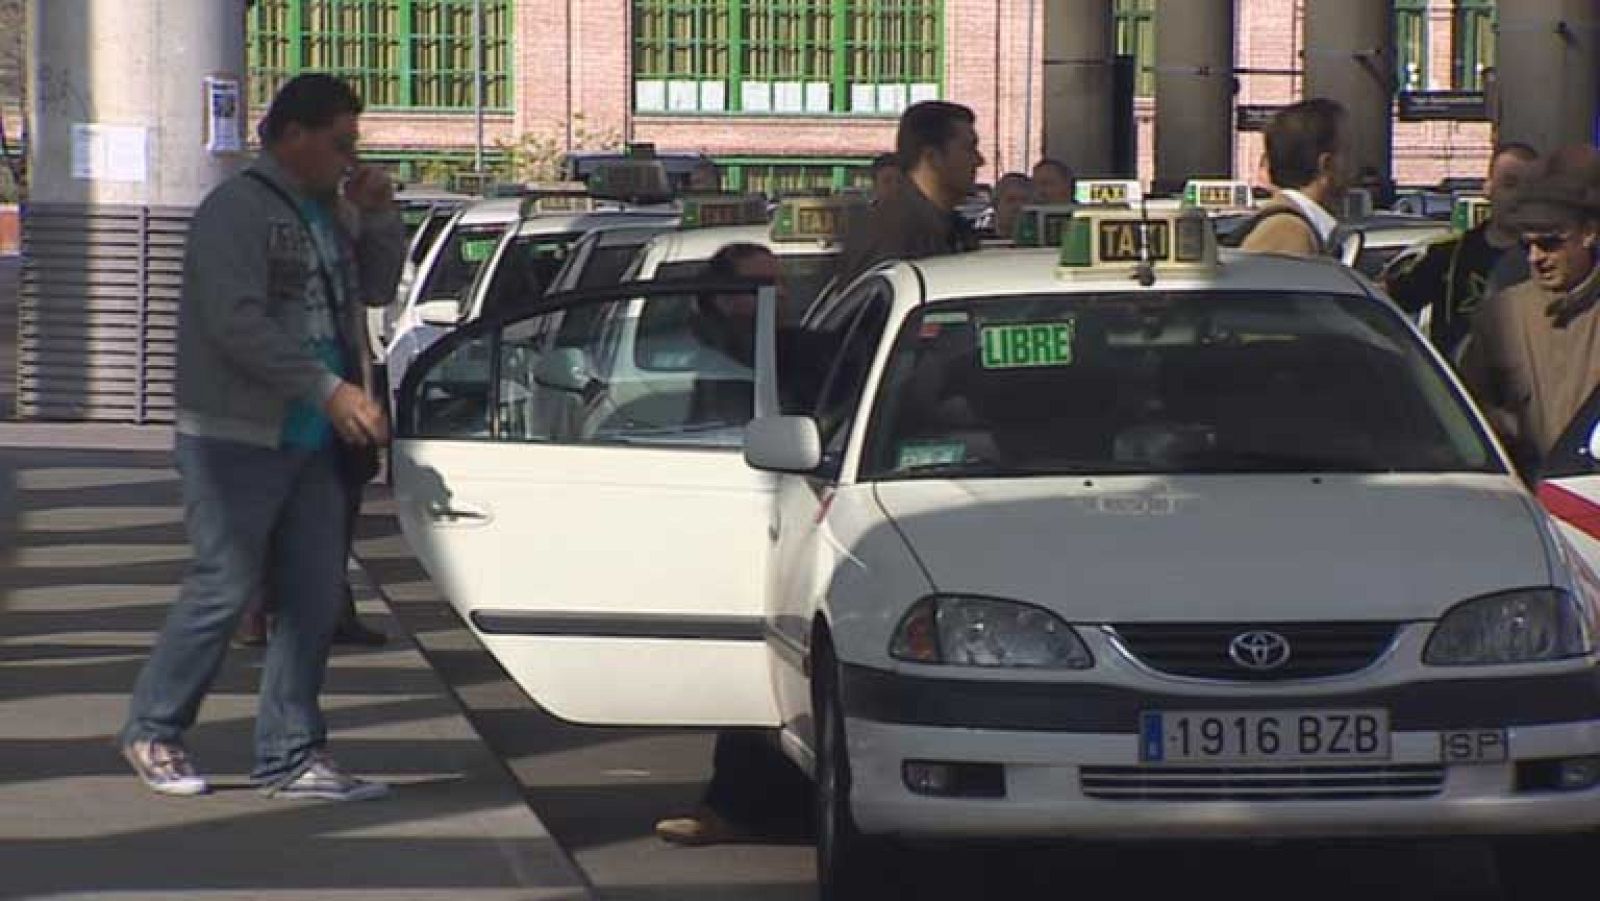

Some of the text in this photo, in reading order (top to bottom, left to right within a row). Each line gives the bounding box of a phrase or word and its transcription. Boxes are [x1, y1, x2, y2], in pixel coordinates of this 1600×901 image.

[1101, 223, 1166, 257] TAXI
[985, 326, 1068, 365] LIBRE
[1177, 717, 1280, 756] 1916
[1299, 715, 1379, 754] BZB
[1450, 732, 1499, 759] SP
